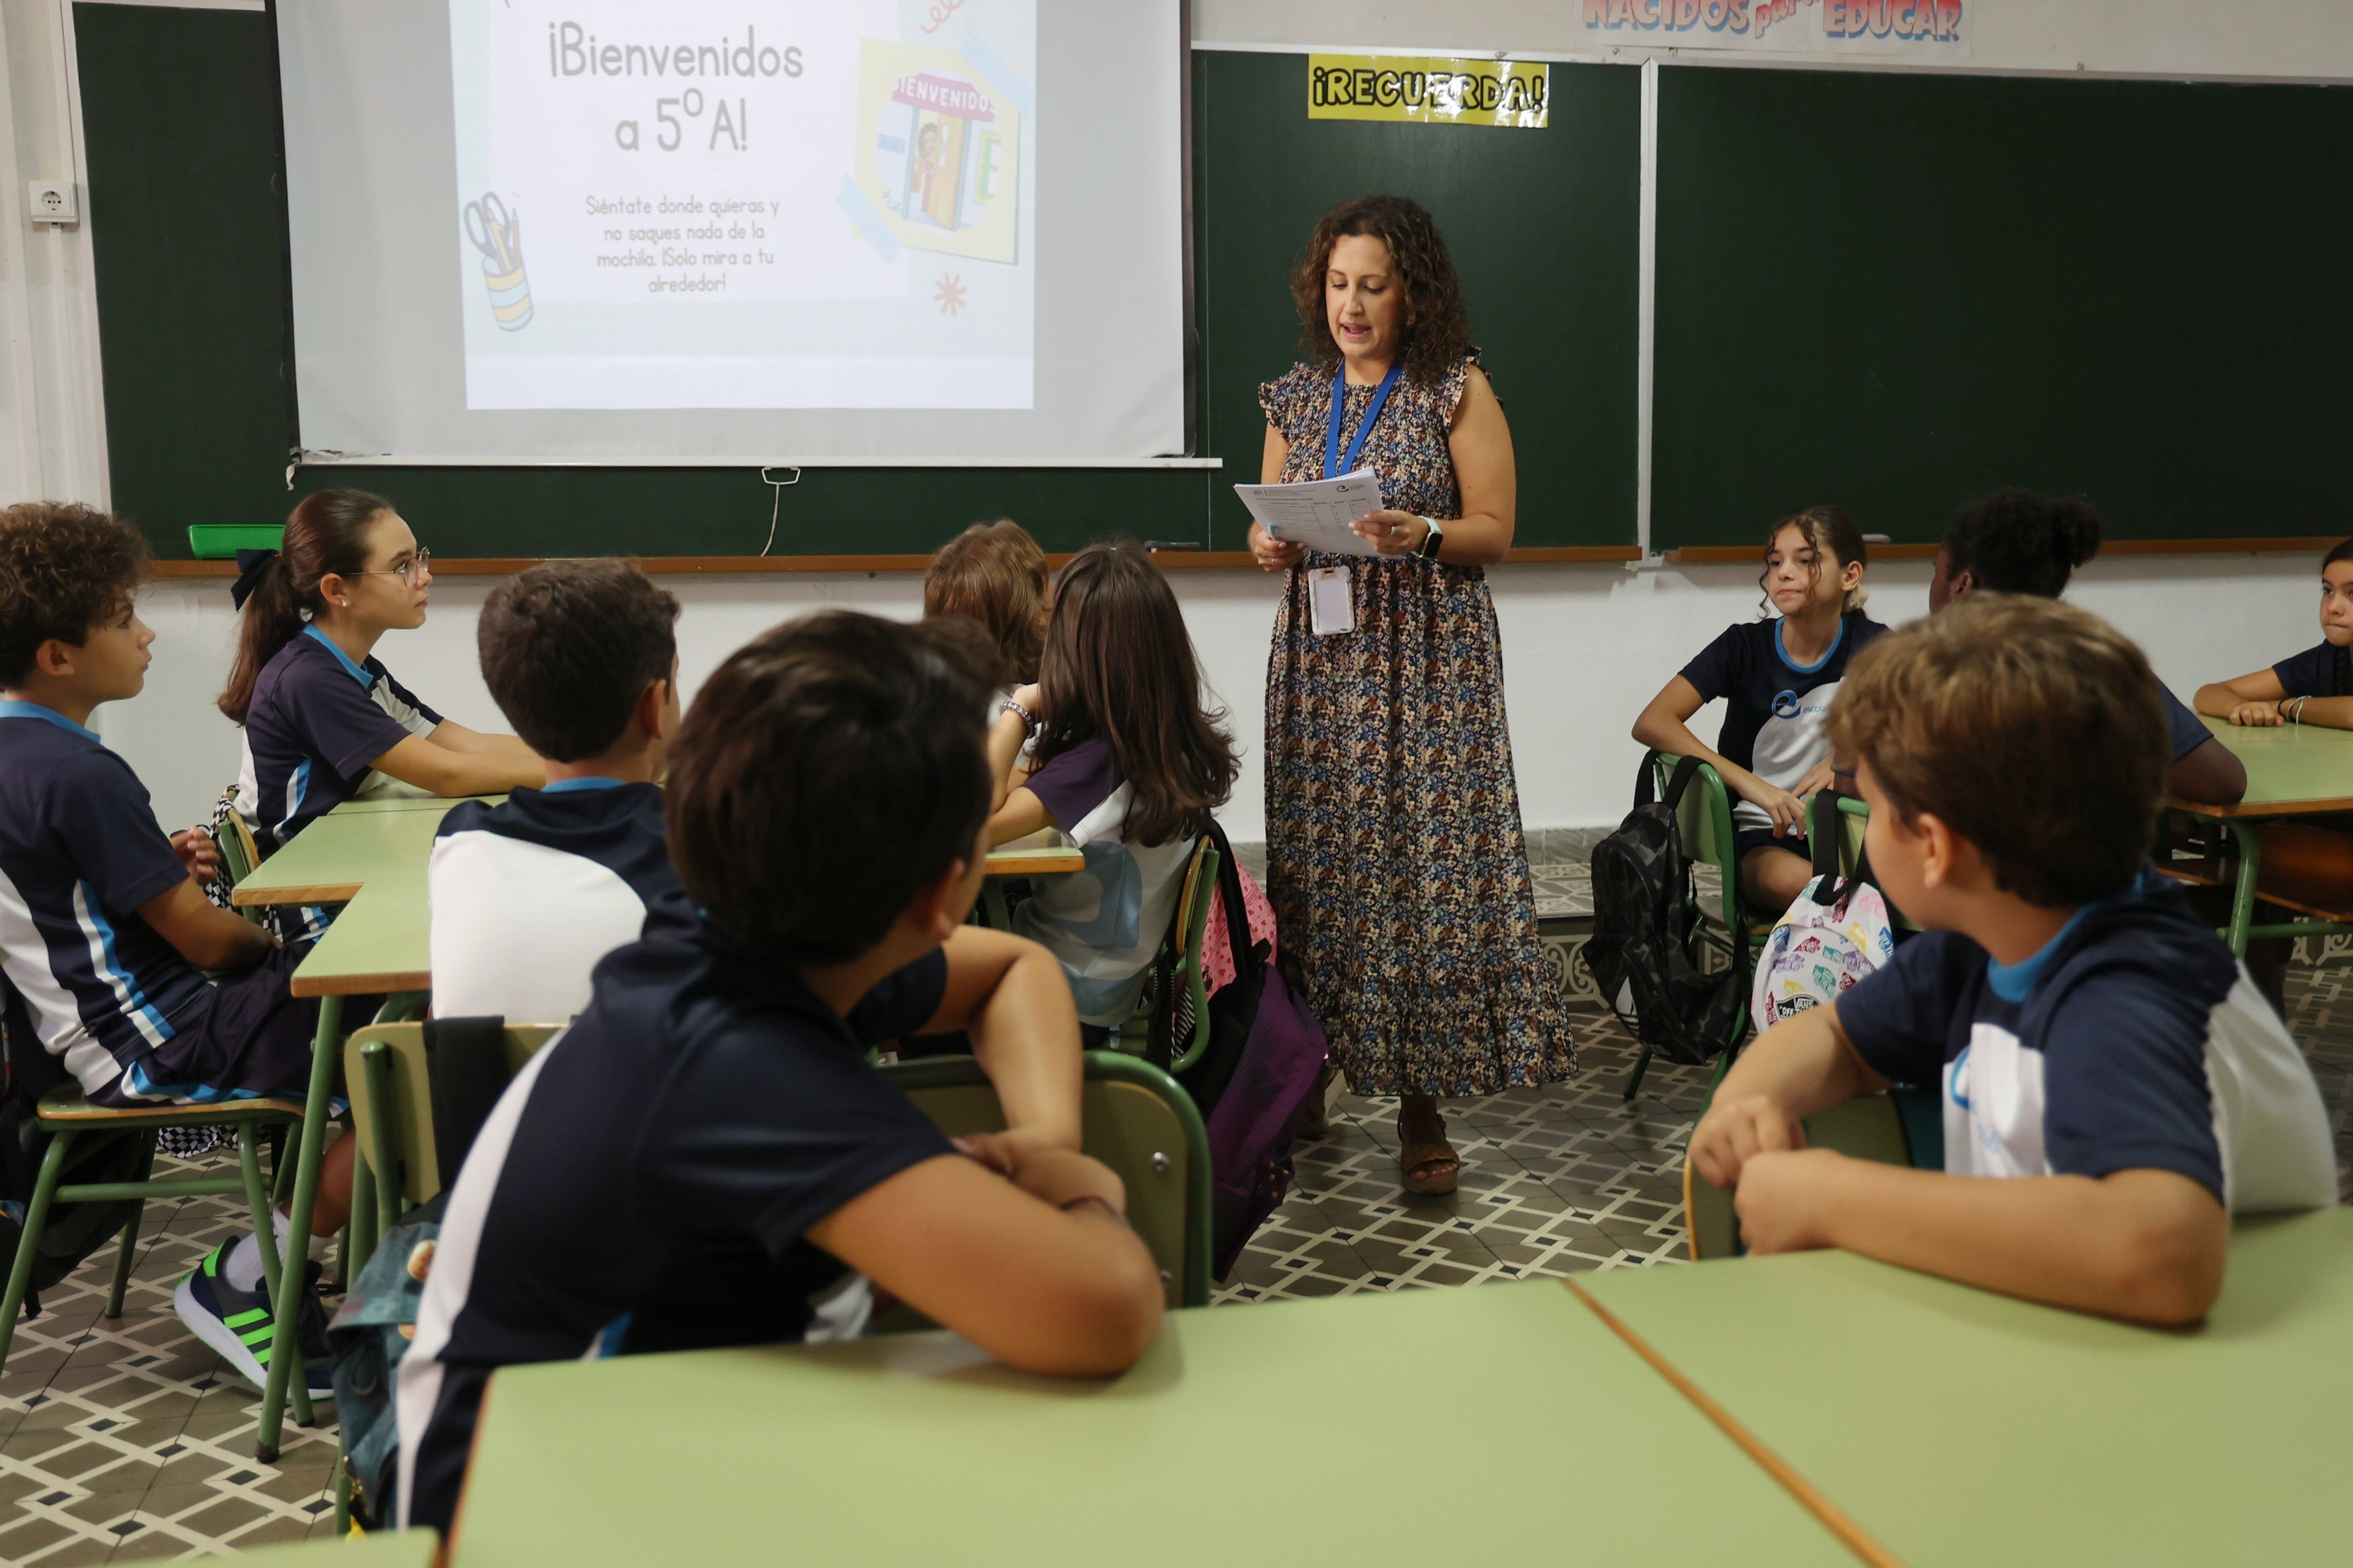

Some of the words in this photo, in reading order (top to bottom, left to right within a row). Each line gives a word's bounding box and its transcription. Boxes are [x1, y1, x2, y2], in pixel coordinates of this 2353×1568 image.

[1583, 0, 1750, 34] NACIDOS
[1755, 0, 1819, 39] par
[1823, 0, 1959, 42] EDUCAR
[548, 21, 803, 79] ¡Bienvenidos
[1313, 66, 1545, 113] ¡RECUERDA!
[615, 120, 639, 152] a
[709, 97, 747, 152] A!
[586, 195, 652, 215] Siéntate
[658, 195, 703, 214] donde
[709, 199, 764, 218] quieras
[770, 201, 779, 217] y
[604, 228, 623, 240] no
[629, 228, 680, 245] saques
[686, 221, 723, 240] nada
[729, 221, 746, 239] de
[752, 221, 764, 239] la
[597, 248, 657, 267] mochila.
[662, 247, 697, 267] ¡Solo
[703, 251, 737, 265] mira
[743, 253, 752, 265] a
[758, 248, 774, 265] tu
[648, 273, 726, 292] alrededor!
[1793, 998, 1814, 1010] VANS
